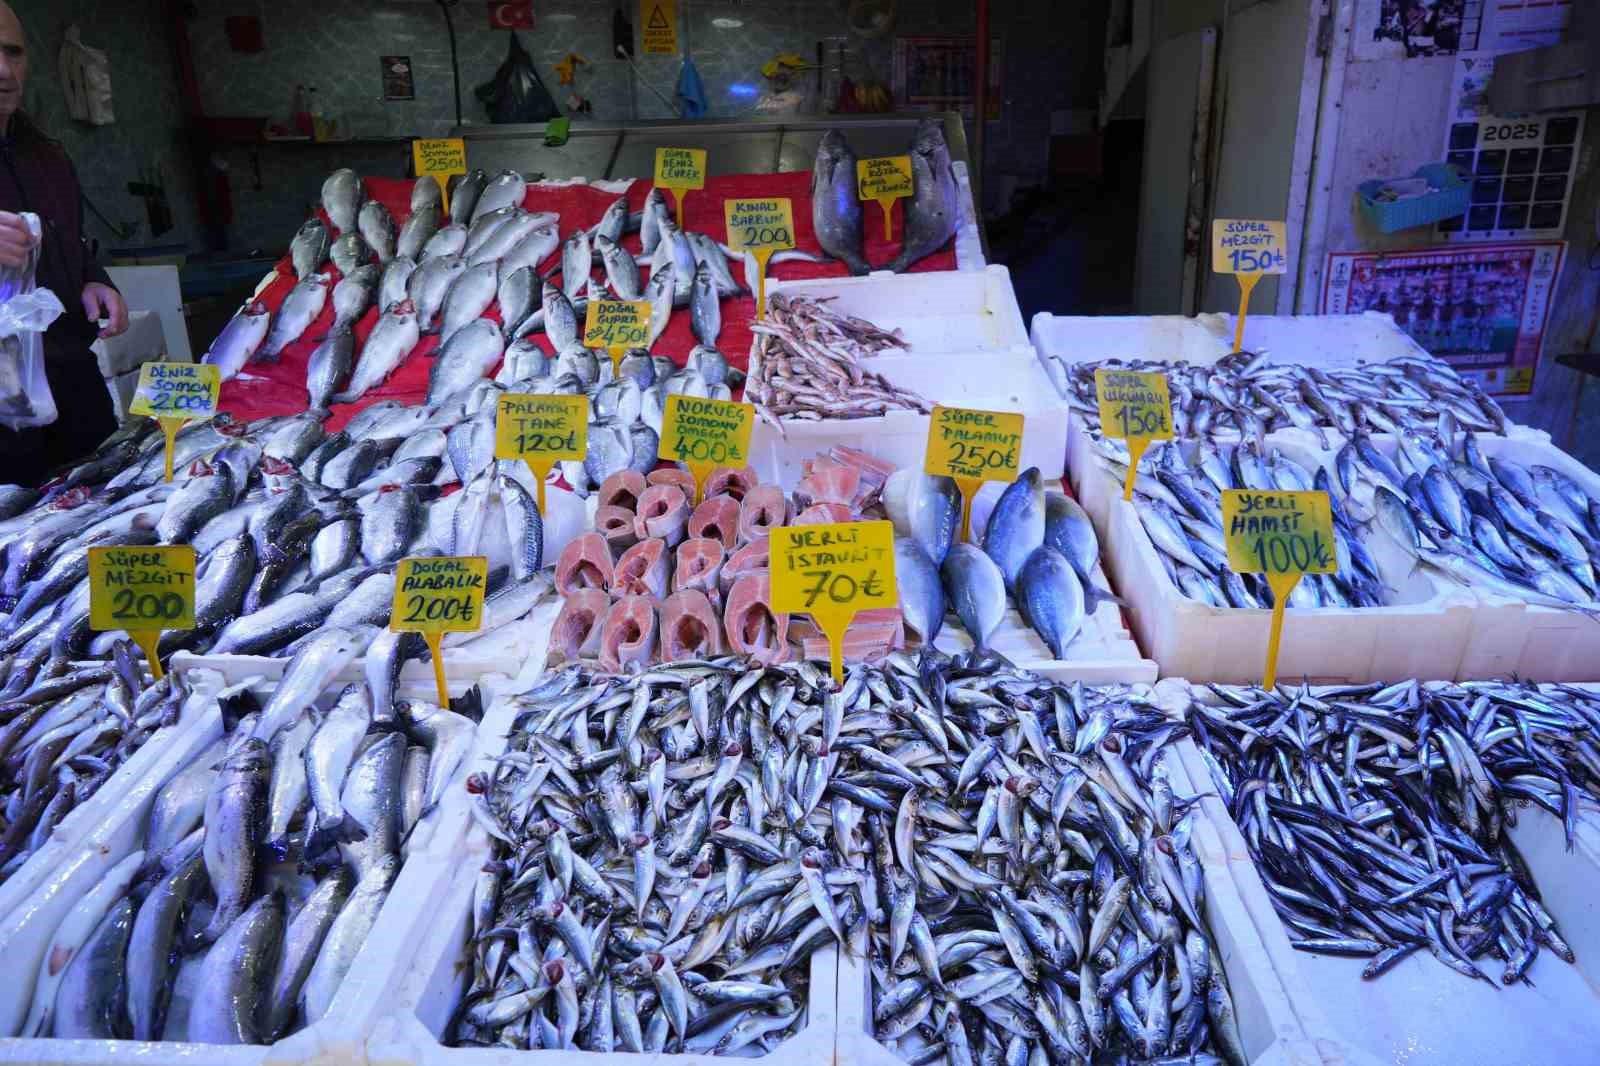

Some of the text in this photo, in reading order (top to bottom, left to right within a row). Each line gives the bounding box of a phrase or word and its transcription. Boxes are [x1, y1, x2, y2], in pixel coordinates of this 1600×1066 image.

[1484, 124, 1540, 141] 2025
[511, 415, 568, 433] TANE
[111, 588, 185, 619] 200
